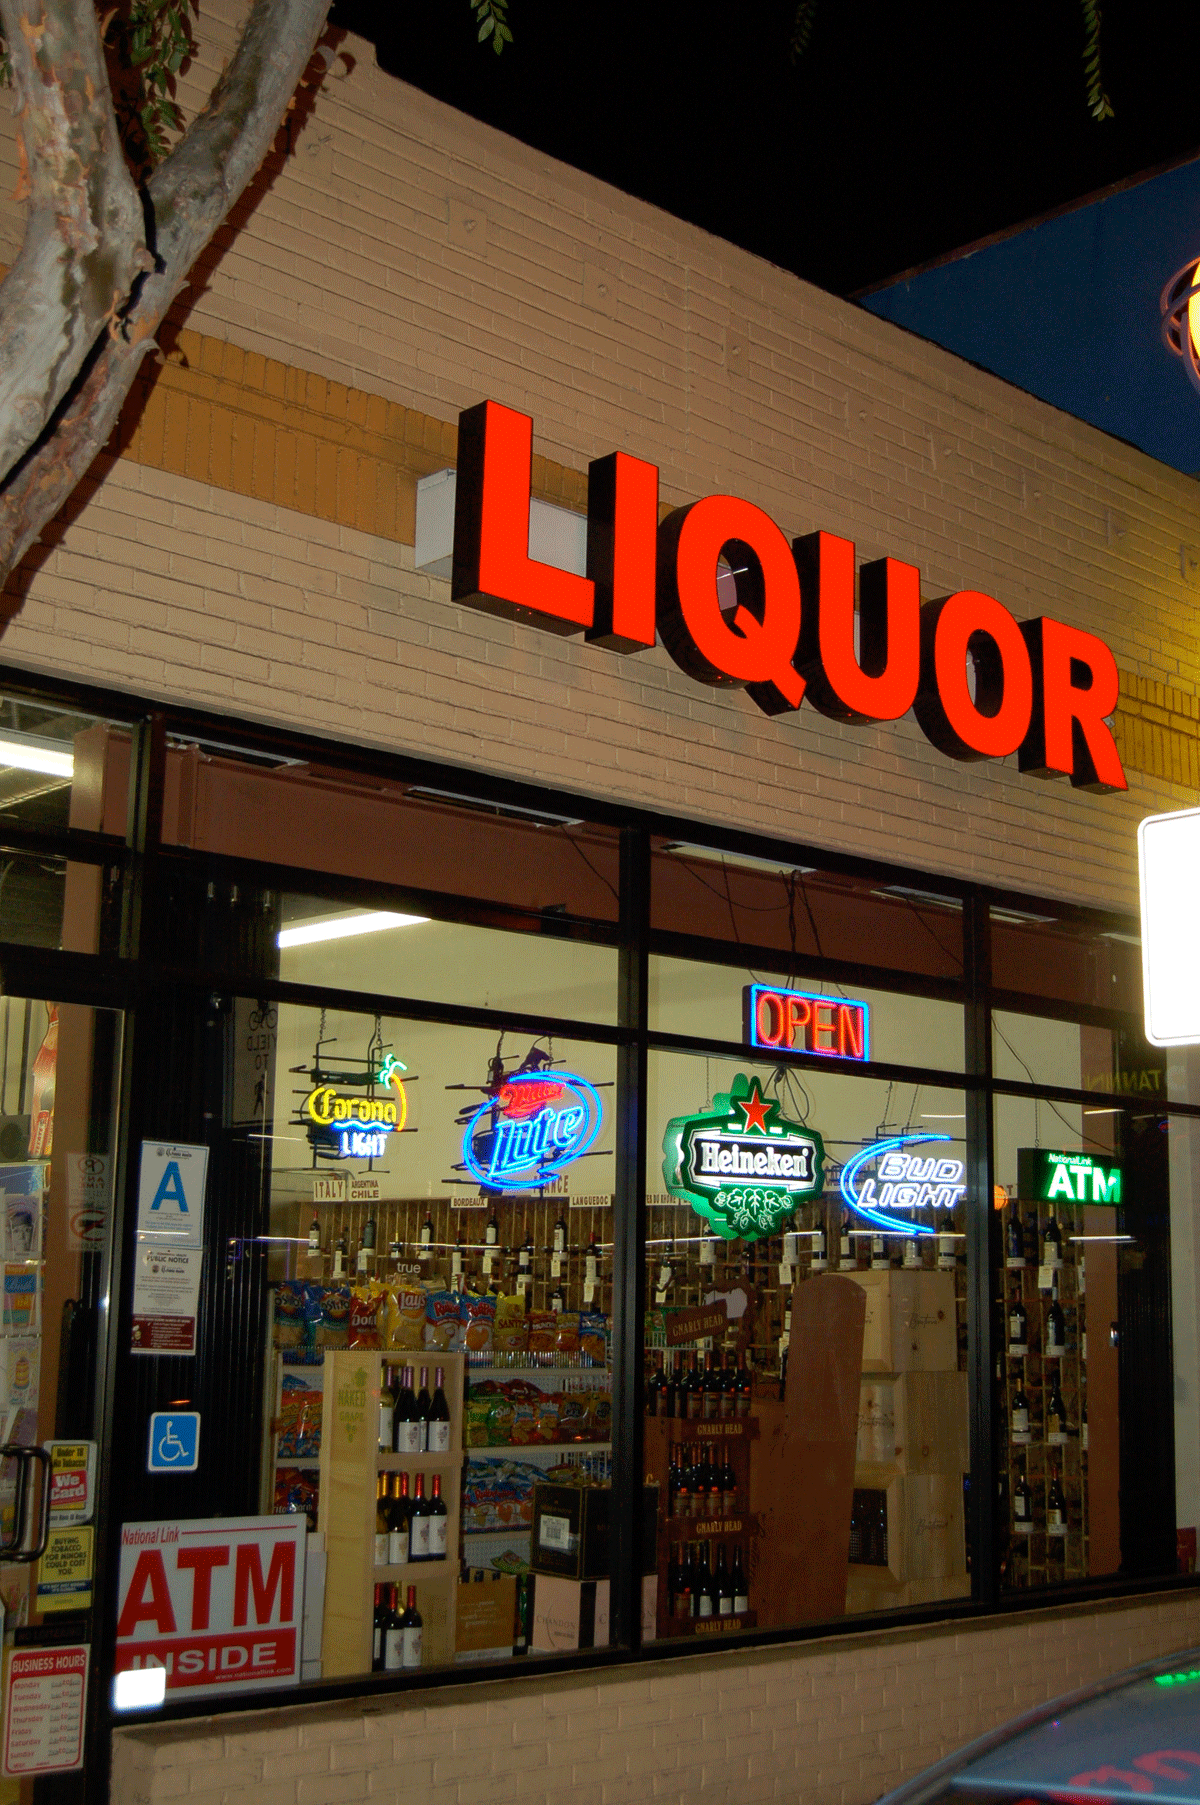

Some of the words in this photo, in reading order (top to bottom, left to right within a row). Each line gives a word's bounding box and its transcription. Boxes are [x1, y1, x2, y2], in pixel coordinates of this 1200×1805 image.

[457, 400, 1128, 791] LIQUOR
[757, 991, 866, 1058] OPEN
[308, 1086, 397, 1125] Corona
[342, 1131, 388, 1158] LIGHT
[488, 1106, 584, 1177] Lite
[701, 1142, 808, 1177] Heineken
[878, 1153, 964, 1183] BUD
[151, 1161, 189, 1212] A
[315, 1181, 343, 1198] ITALY
[1047, 1164, 1122, 1204] ATM
[351, 1190, 379, 1199] CHILE
[572, 1196, 609, 1205] LANGUEDOC
[857, 1178, 967, 1208] LIGHT
[453, 1198, 486, 1206] BORDEAUX
[146, 1255, 167, 1264] PUBLIC
[168, 1256, 189, 1265] NOTICE
[396, 1261, 421, 1274] true
[673, 1319, 701, 1337] GNARLY
[704, 1314, 723, 1328] HEAD
[338, 1390, 366, 1407] NAKED
[339, 1411, 364, 1422] GRAPE
[697, 1424, 723, 1435] GNARLY
[725, 1423, 743, 1434] HEAD
[56, 1474, 80, 1487] We
[51, 1484, 85, 1500] Card
[696, 1521, 722, 1534] GNARLY
[724, 1520, 742, 1532] HEAD
[55, 1537, 79, 1545] BUYING
[122, 1528, 159, 1545] National
[160, 1526, 179, 1543] Link
[46, 1561, 67, 1569] COULD
[69, 1559, 85, 1567] COST
[61, 1552, 86, 1560] MINORS
[117, 1541, 296, 1637] ATM
[536, 1614, 576, 1630] CHANDON
[695, 1620, 722, 1634] GNARLY
[723, 1618, 742, 1631] HEAD
[12, 1656, 54, 1673] BUSINESS
[55, 1654, 85, 1669] HOURS
[132, 1642, 277, 1675] INSIDE
[14, 1693, 41, 1701] Tuesday
[13, 1703, 50, 1712] Wednesday
[13, 1716, 43, 1724] Thursday
[11, 1739, 41, 1747] Saturday
[10, 1751, 34, 1759] Sunday
